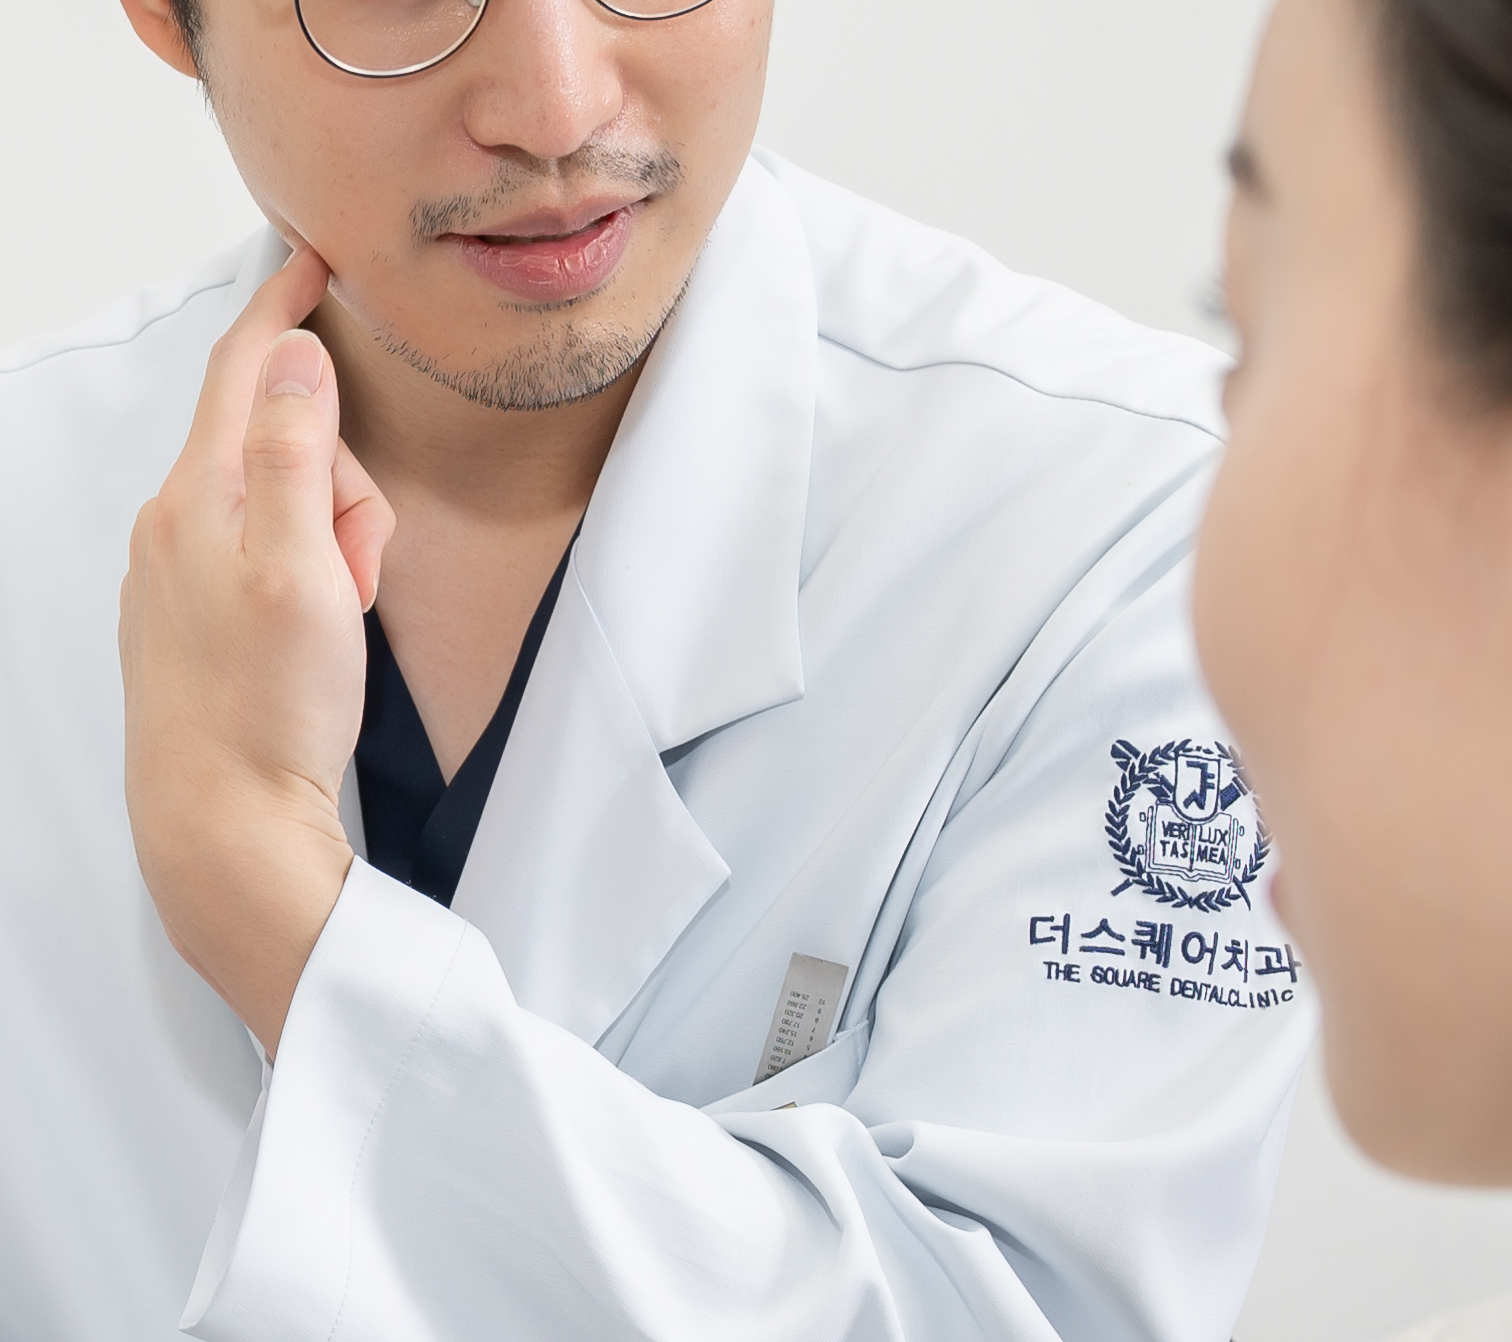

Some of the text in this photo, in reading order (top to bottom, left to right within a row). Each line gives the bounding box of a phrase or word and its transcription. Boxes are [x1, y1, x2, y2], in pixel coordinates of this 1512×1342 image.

[1161, 820, 1190, 841] VERI
[1198, 824, 1229, 847] LUX
[1159, 839, 1189, 859] TAS
[1196, 844, 1227, 866] MEA
[1043, 960, 1081, 983] THE
